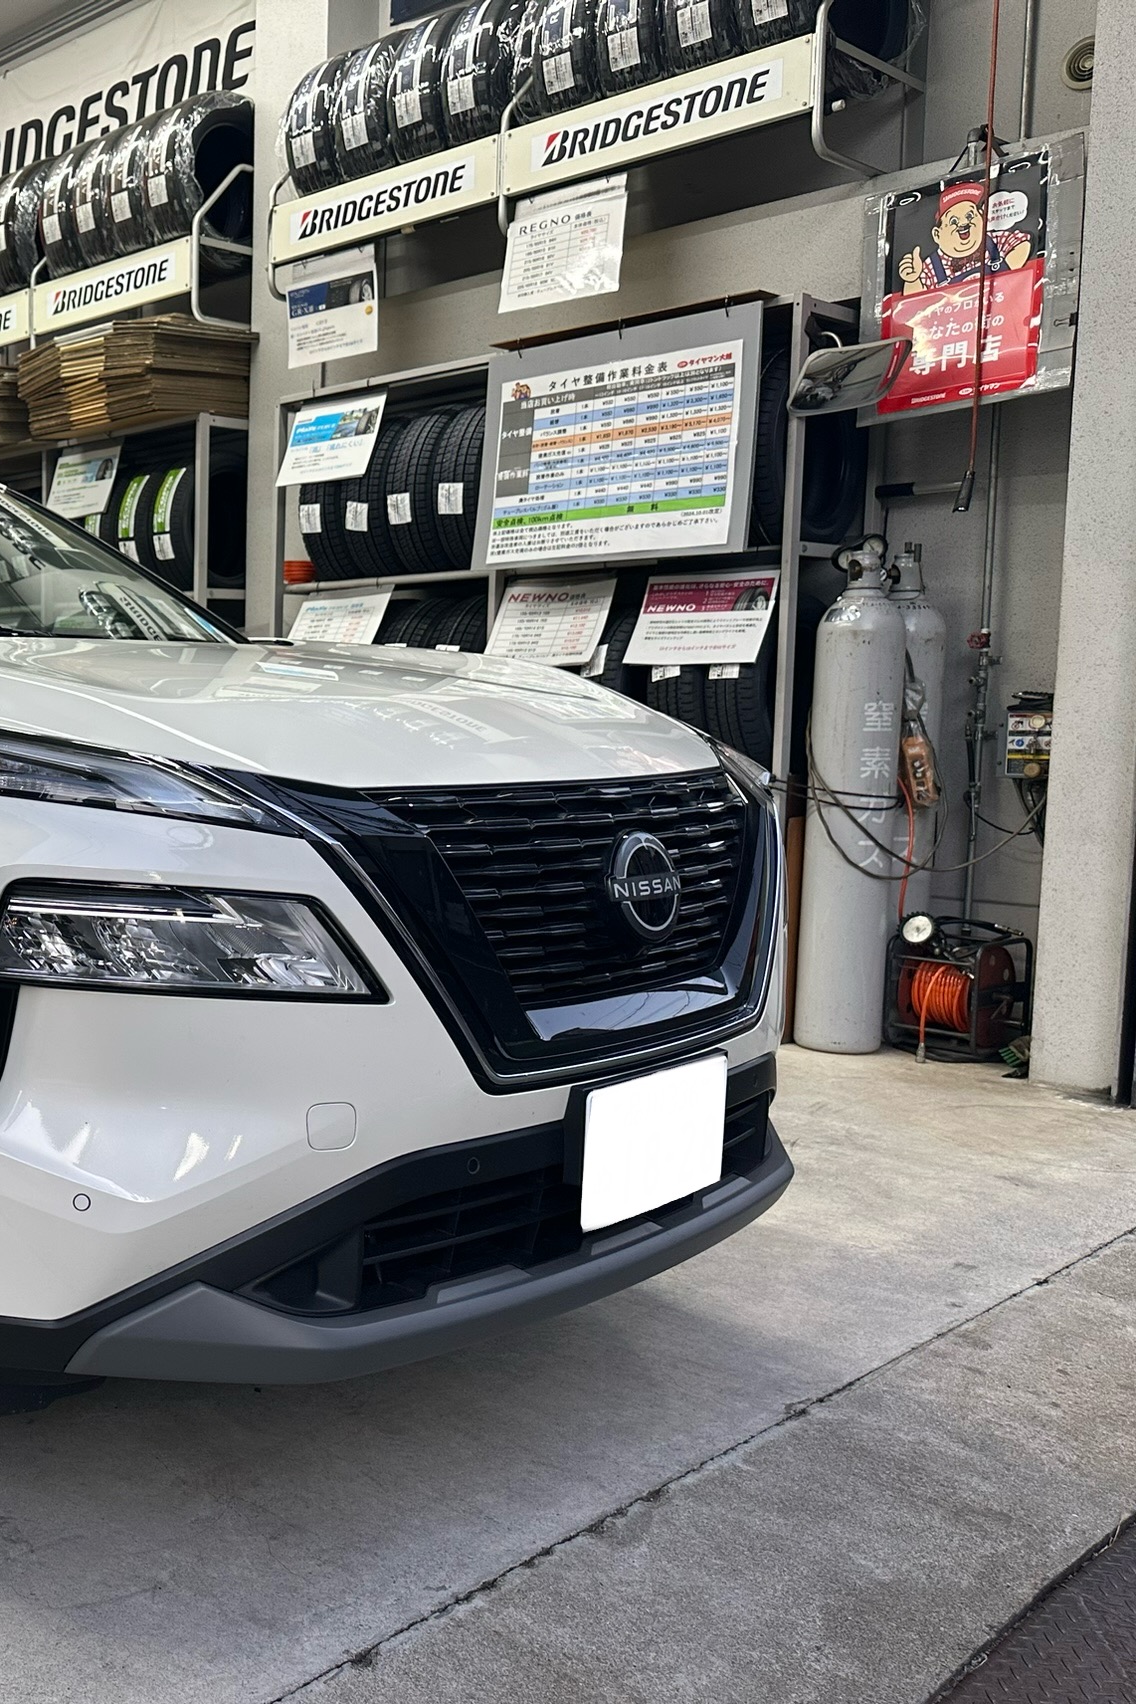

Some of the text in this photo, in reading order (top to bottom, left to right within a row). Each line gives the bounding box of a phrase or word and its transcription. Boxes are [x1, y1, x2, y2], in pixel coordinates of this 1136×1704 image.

[542, 69, 770, 168] BRIDGESTONE
[298, 163, 466, 240] BRIDGESTONE
[519, 214, 571, 236] REGNO
[52, 258, 170, 317] BRIDGESTONE
[548, 360, 668, 392] タイヤ整備作業料金表
[508, 592, 570, 603] NEWNO
[647, 603, 696, 612] NEWNO
[613, 876, 681, 898] NISSAN
